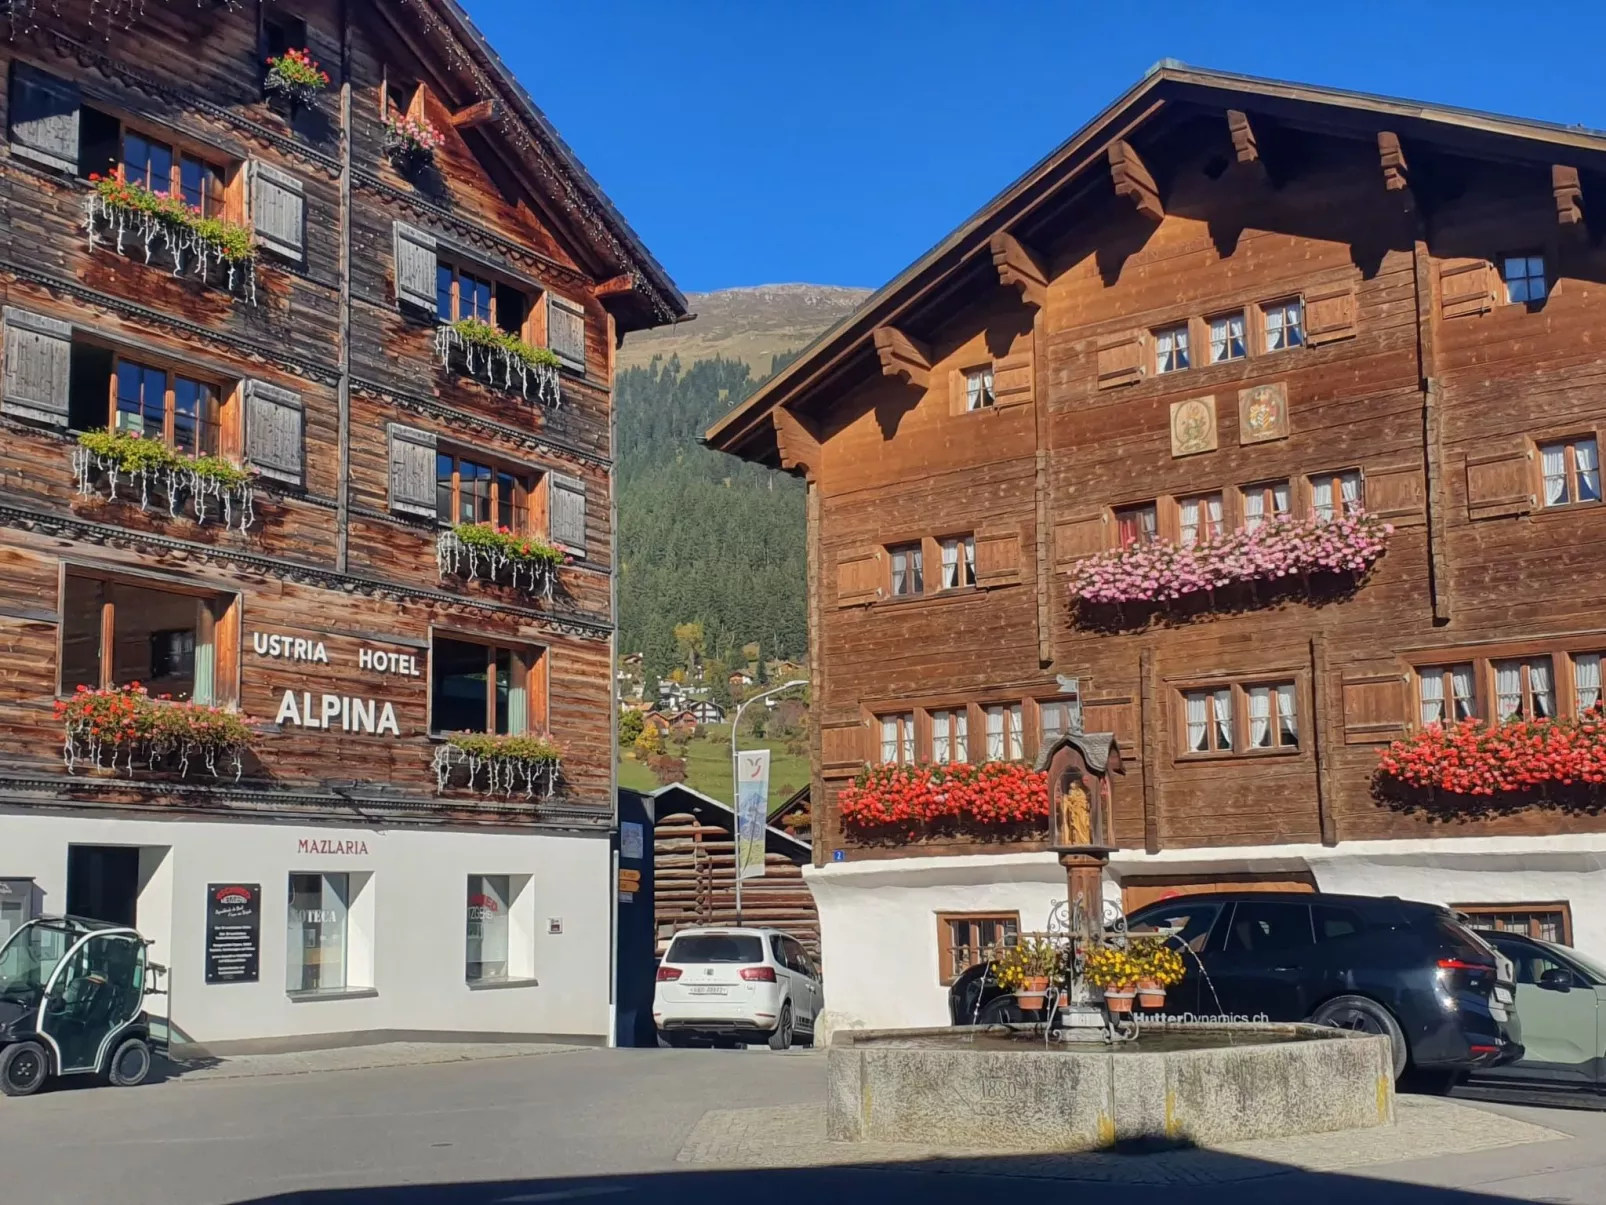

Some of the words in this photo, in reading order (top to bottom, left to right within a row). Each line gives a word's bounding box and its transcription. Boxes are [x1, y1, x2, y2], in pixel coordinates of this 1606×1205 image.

[253, 632, 328, 663] USTRIA
[358, 648, 420, 676] HOTEL
[275, 689, 400, 736] ALPINA
[297, 839, 369, 855] MAZLARIA
[1133, 1012, 1269, 1023] HutterDynamicsch
